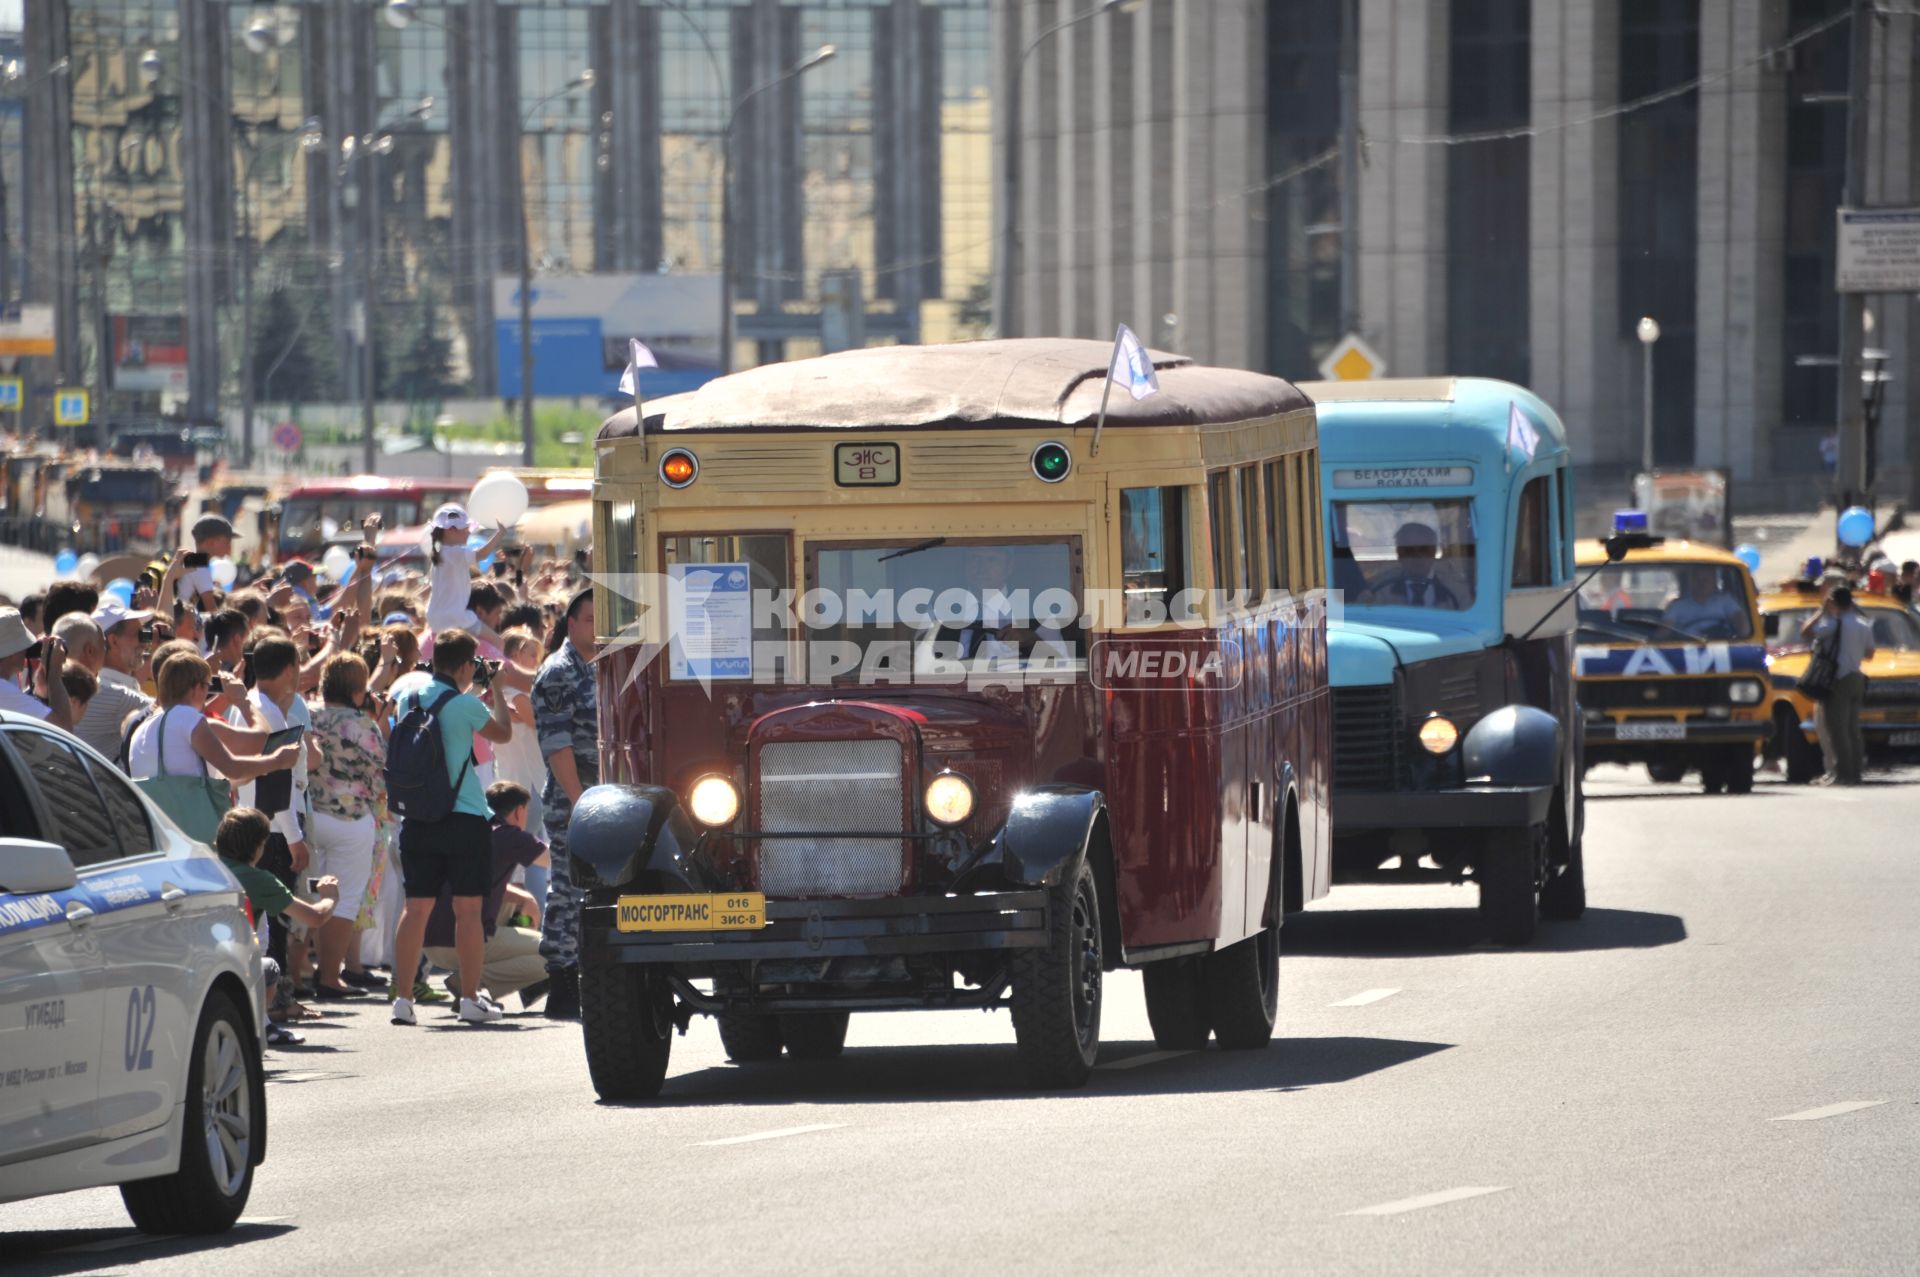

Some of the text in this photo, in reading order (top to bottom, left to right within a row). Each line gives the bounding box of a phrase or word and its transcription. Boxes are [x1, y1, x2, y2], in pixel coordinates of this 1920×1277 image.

[1575, 643, 1731, 676] ГАИ
[727, 899, 749, 908] 016
[621, 904, 709, 922] МОСГОРТРАНС
[721, 915, 756, 925] ЗИС-8
[125, 986, 156, 1072] 02
